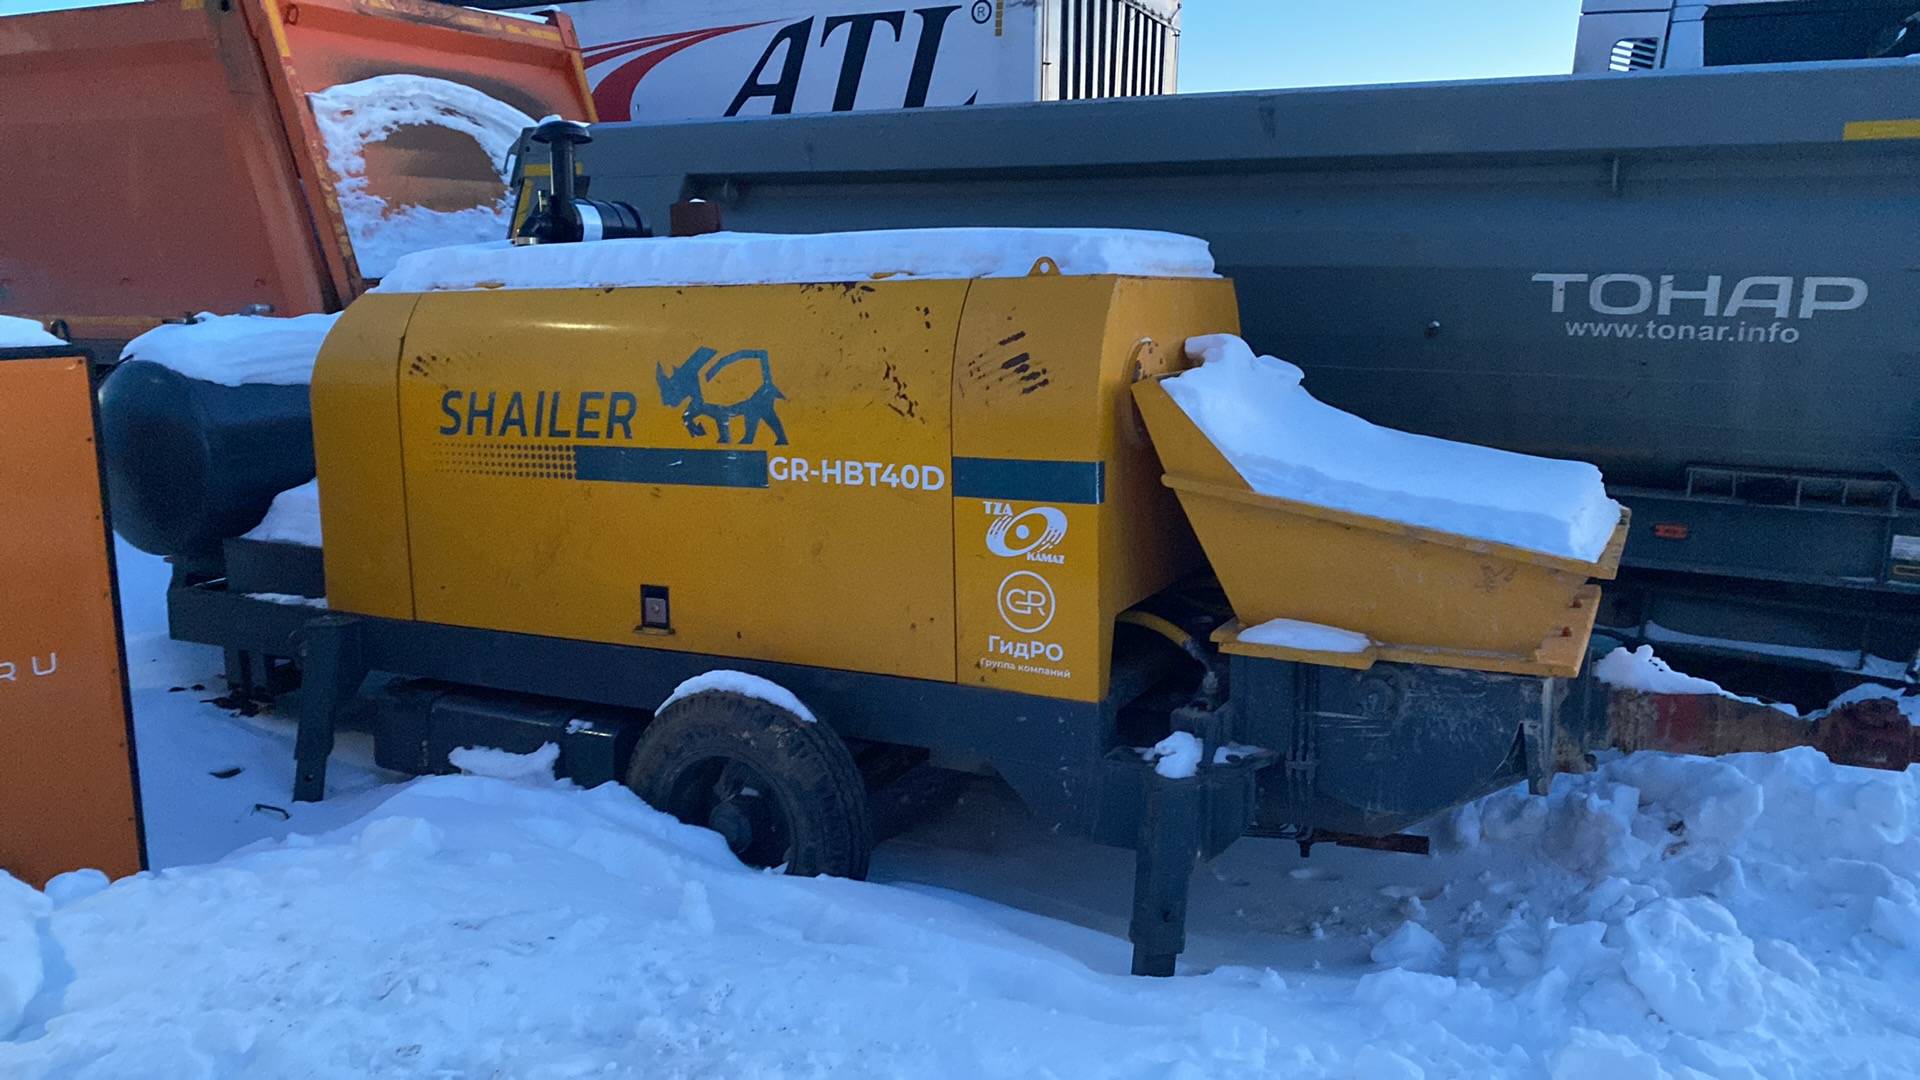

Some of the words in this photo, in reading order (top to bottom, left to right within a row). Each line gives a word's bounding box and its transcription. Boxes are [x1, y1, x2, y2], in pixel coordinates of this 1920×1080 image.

[723, 5, 978, 117] ATL
[1531, 273, 1869, 319] ТОНАР
[1565, 320, 1800, 343] www.tonar.info
[440, 391, 638, 439] SHAILER
[768, 456, 945, 491] GR-HBT40D
[1026, 552, 1065, 565] KAMAZ
[980, 657, 1016, 671] Группа
[1017, 663, 1072, 679] компаний
